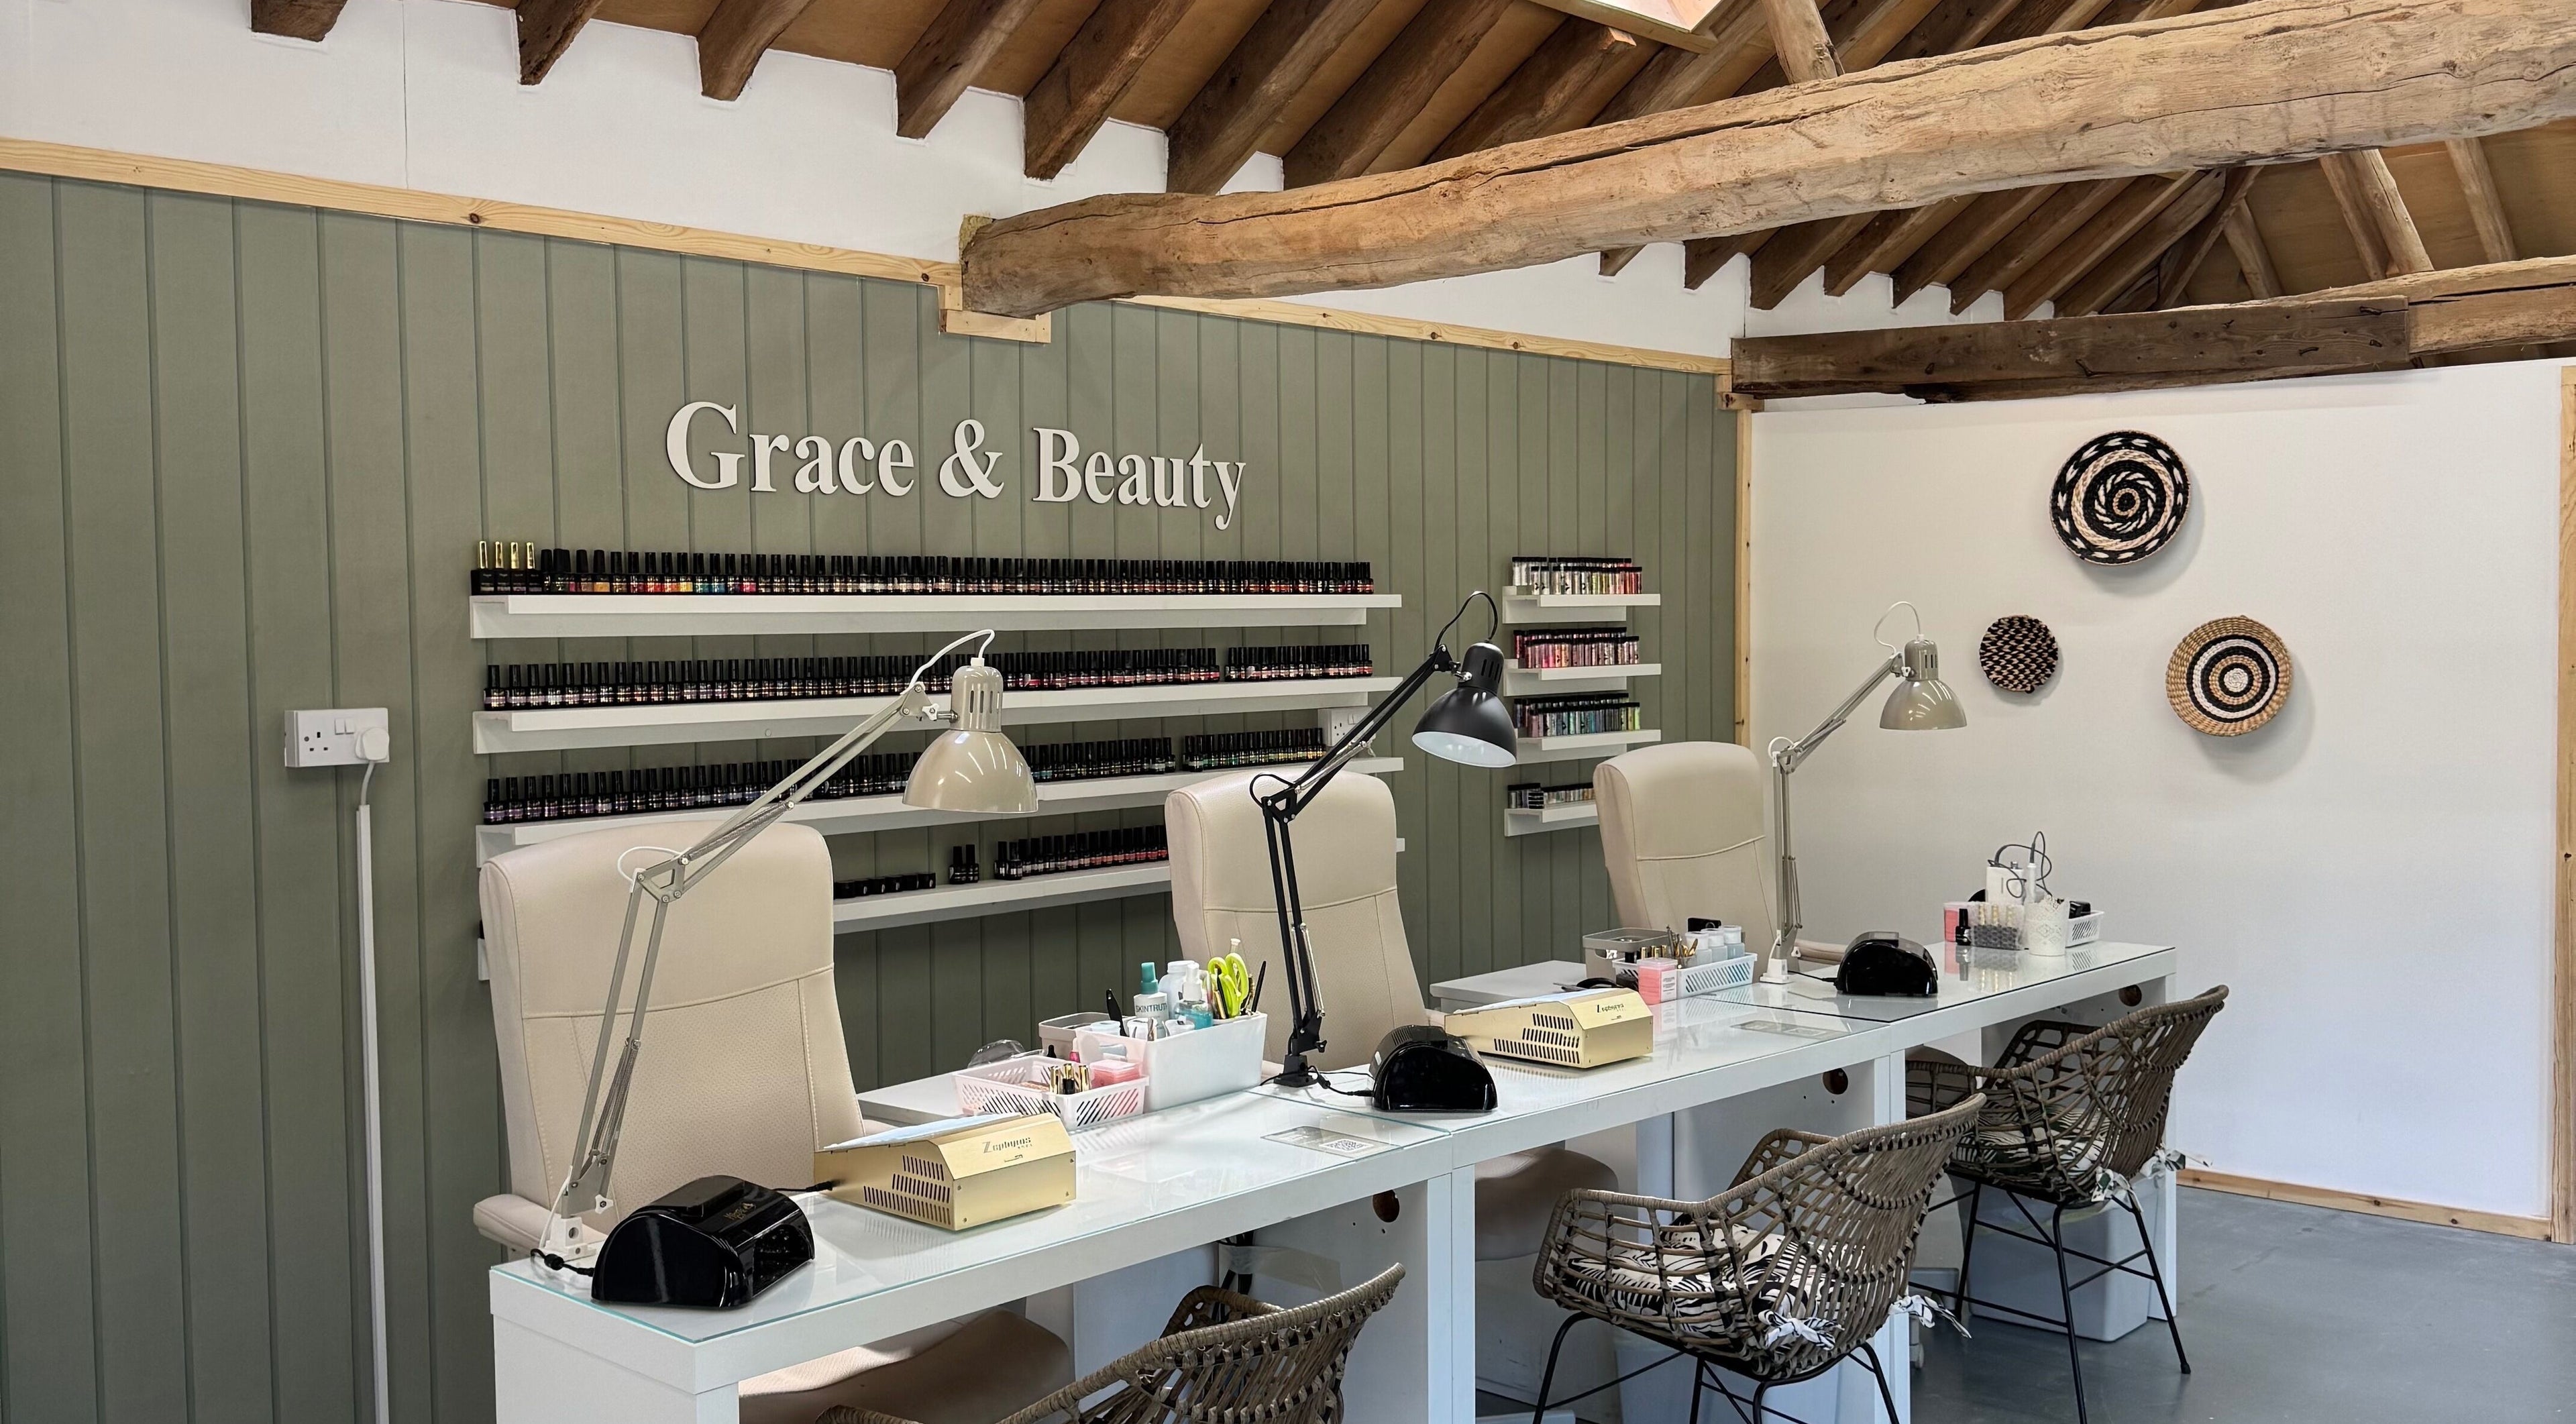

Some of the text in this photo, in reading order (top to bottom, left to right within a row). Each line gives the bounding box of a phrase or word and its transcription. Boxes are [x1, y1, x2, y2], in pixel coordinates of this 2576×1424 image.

[665, 400, 1246, 531] Grace & Beauty
